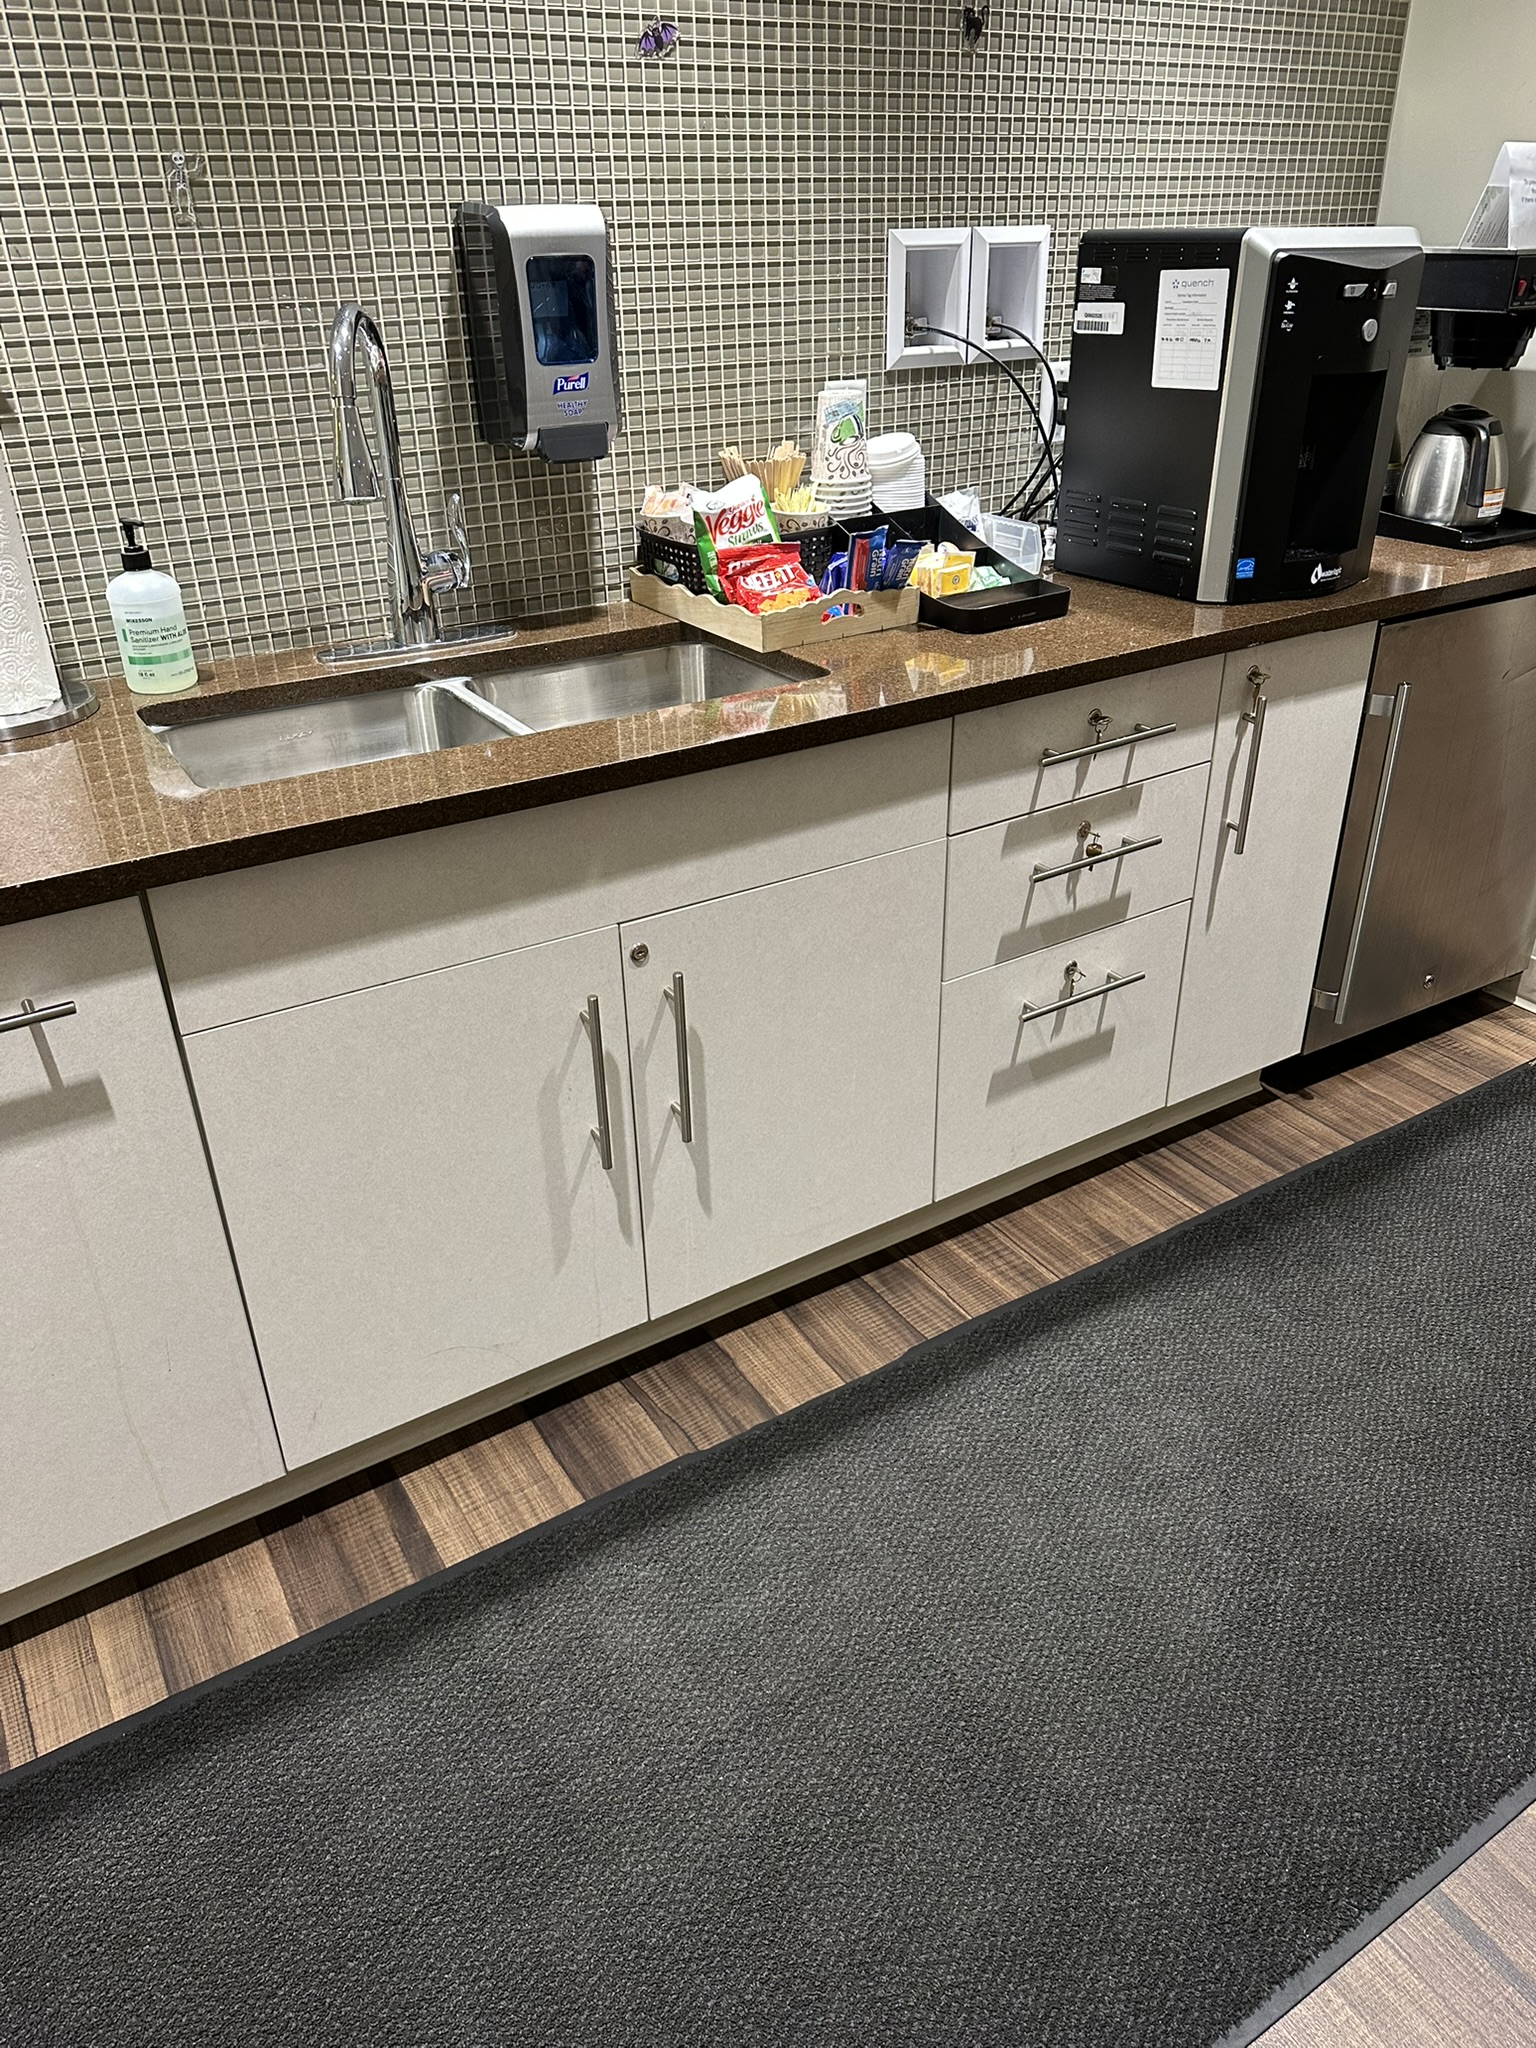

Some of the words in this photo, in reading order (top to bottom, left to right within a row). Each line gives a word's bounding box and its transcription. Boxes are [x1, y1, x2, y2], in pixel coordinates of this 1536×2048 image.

[1181, 278, 1214, 289] quench
[557, 378, 586, 391] Purell
[557, 400, 588, 409] HEALTHY
[564, 408, 583, 417] SOAP
[705, 499, 765, 545] Veggie
[727, 522, 764, 546] Straws
[869, 549, 880, 578] Grain
[128, 627, 160, 637] Premium
[159, 624, 178, 634] Hand
[130, 635, 160, 644] Sanitizer
[159, 632, 178, 641] WITH
